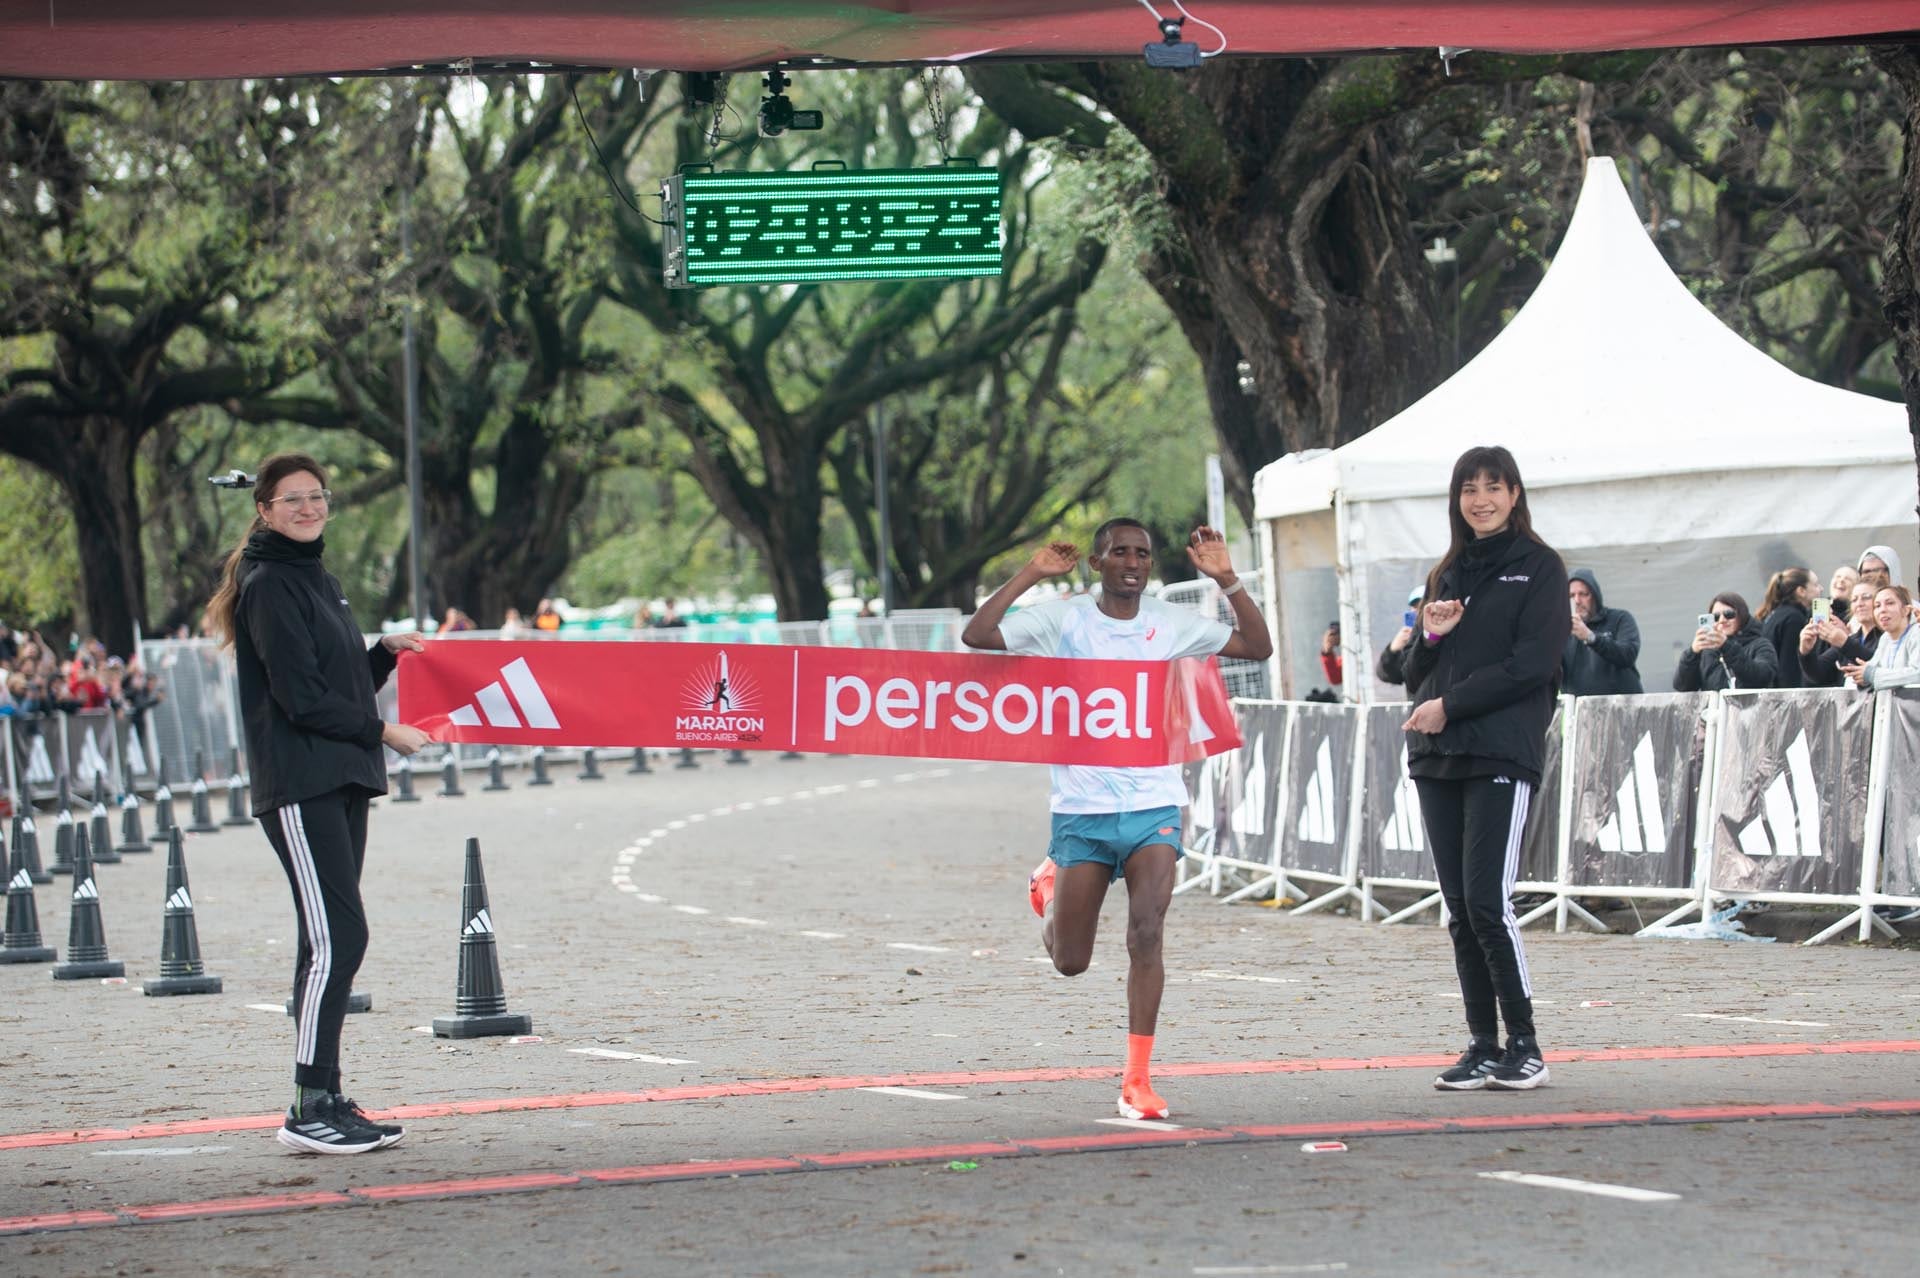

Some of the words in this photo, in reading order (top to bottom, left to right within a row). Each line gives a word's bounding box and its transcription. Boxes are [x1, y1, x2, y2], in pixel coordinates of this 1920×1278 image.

[824, 672, 1152, 741] personal
[675, 716, 764, 731] MARATON
[676, 732, 712, 741] BUENOS
[713, 733, 738, 742] AIRES
